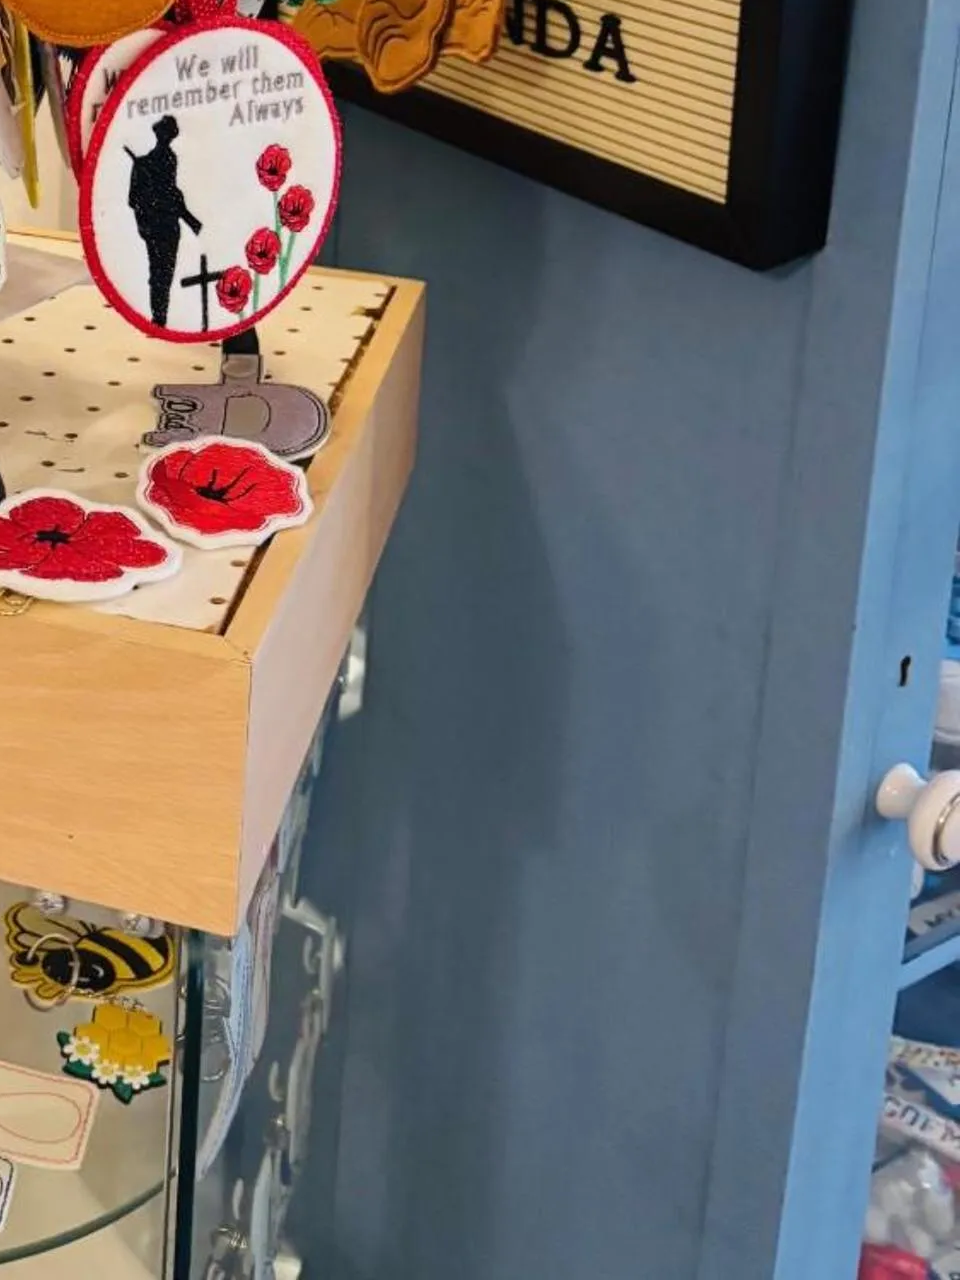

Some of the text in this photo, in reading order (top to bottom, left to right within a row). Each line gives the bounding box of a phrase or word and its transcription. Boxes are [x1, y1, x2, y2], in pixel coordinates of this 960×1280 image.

[174, 45, 259, 82] We will
[126, 78, 242, 119] remember
[251, 71, 305, 95] them
[228, 95, 305, 127] Always
